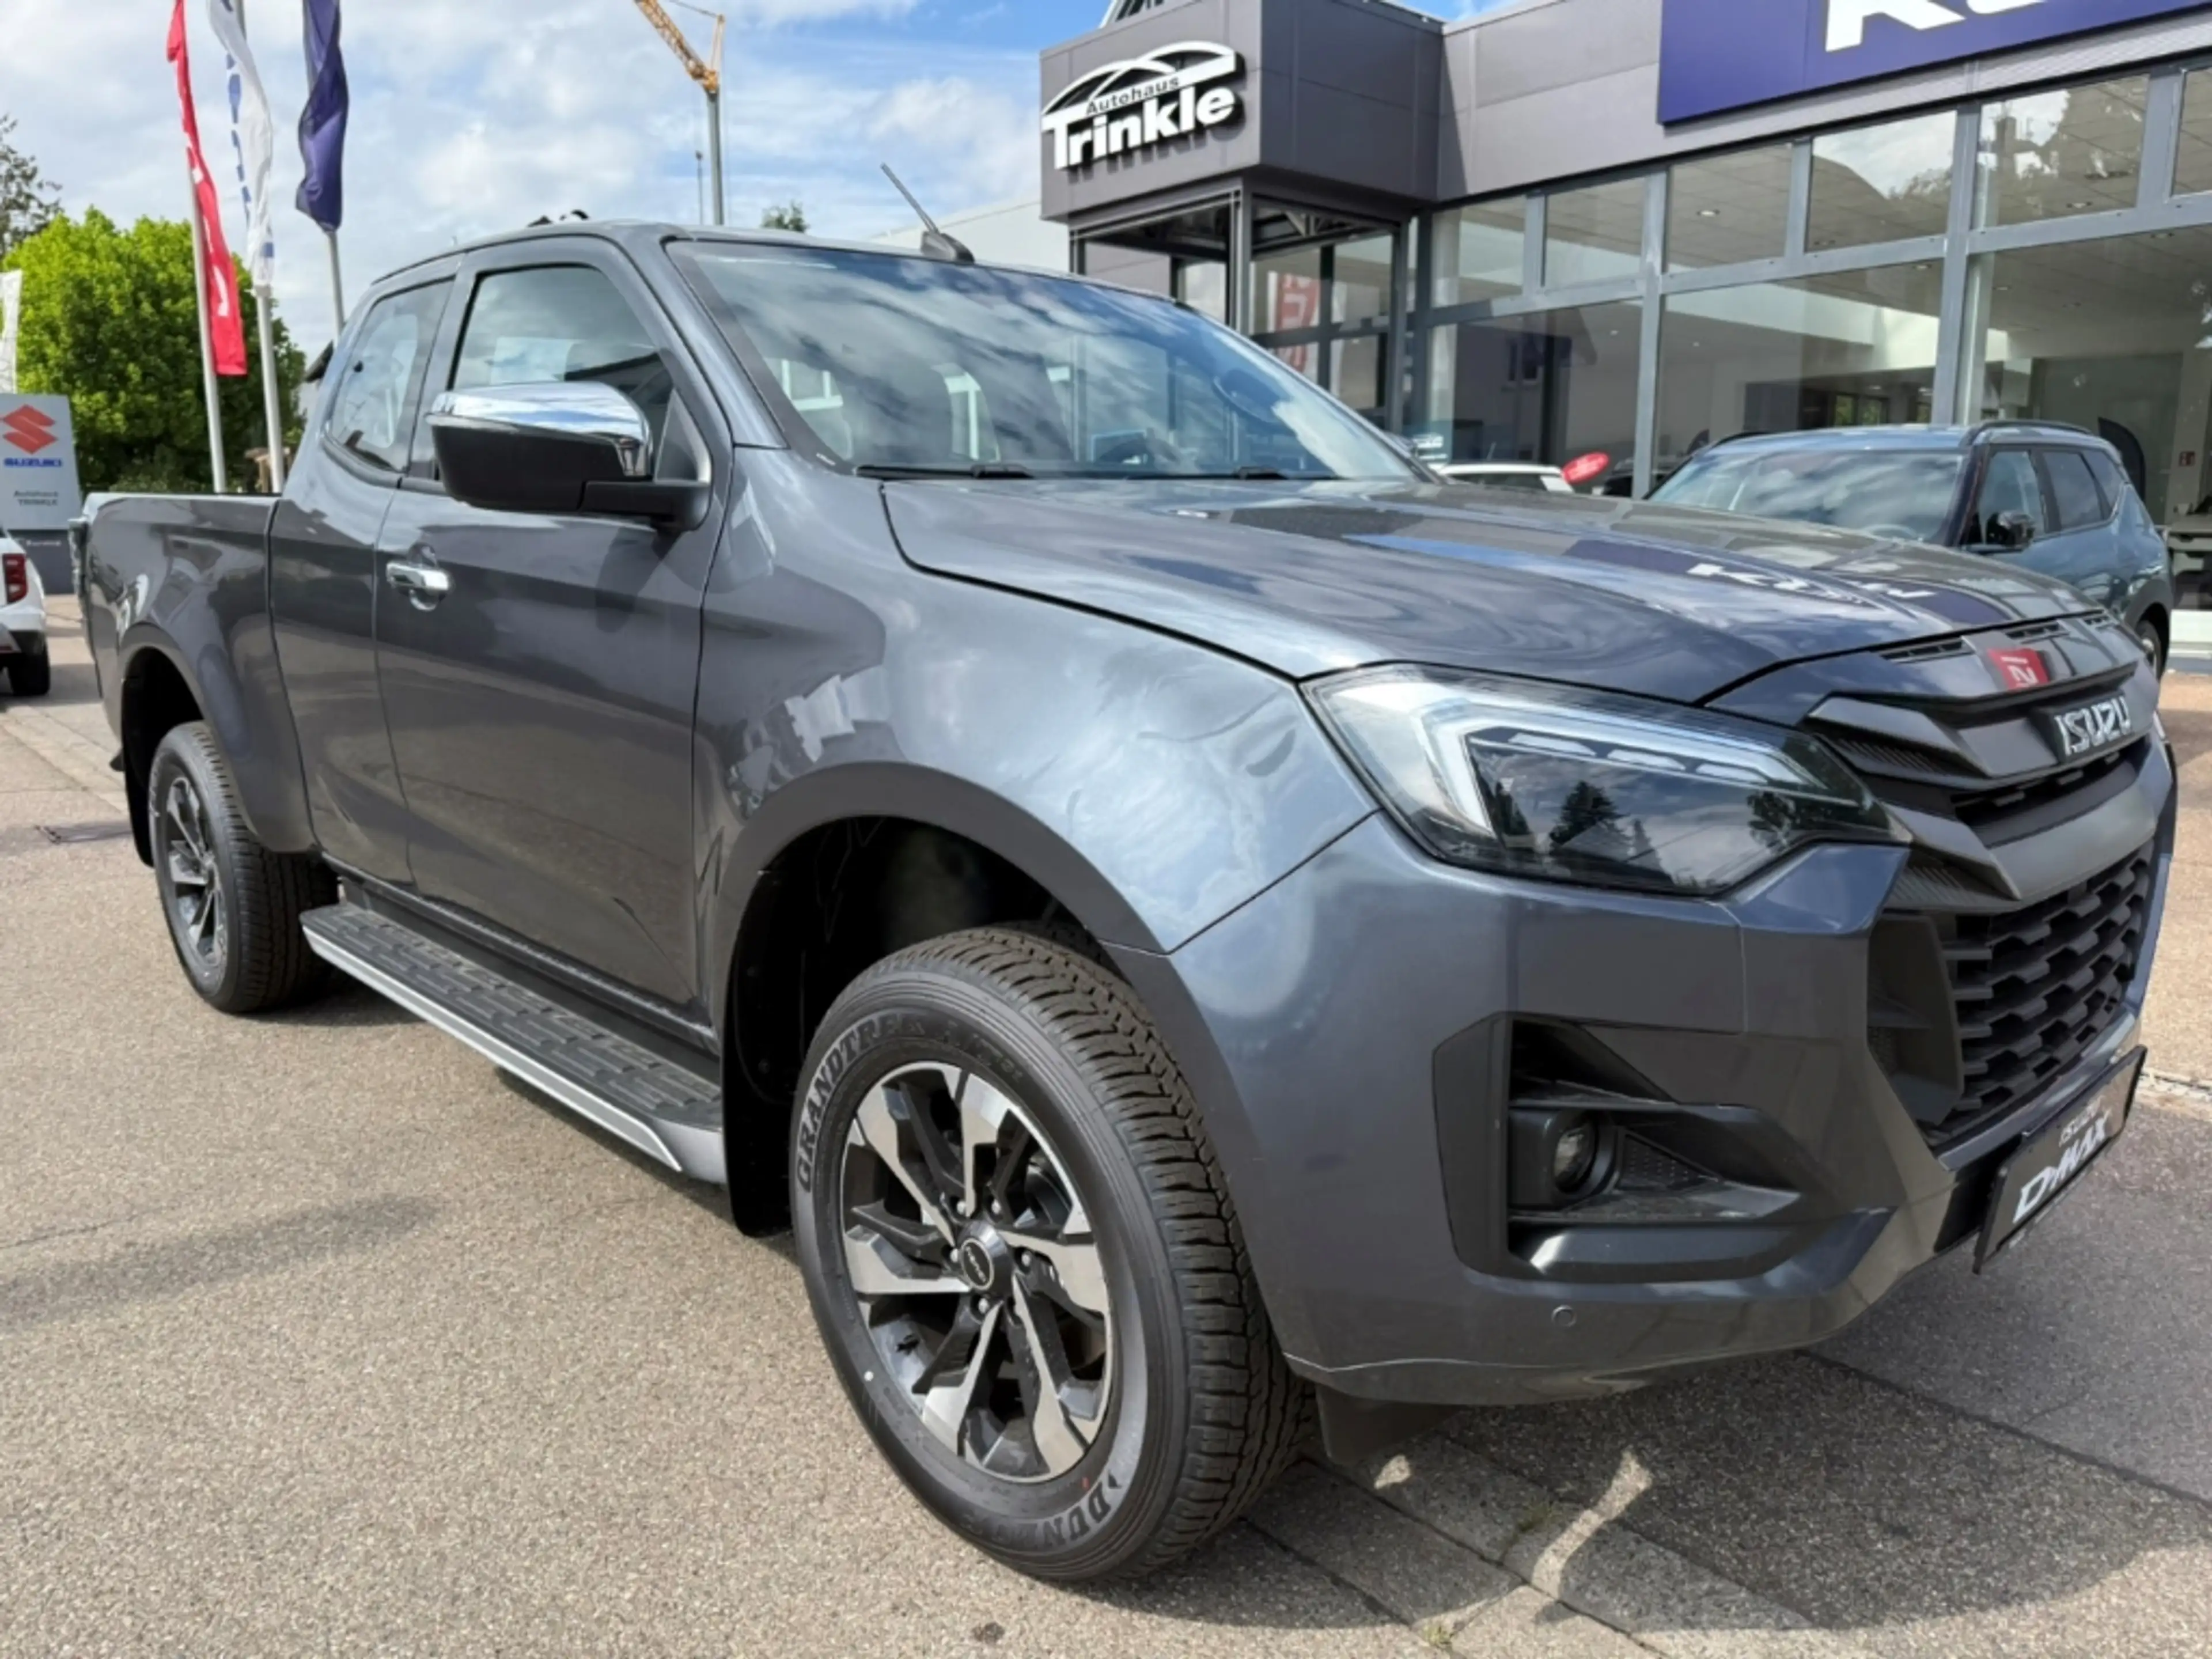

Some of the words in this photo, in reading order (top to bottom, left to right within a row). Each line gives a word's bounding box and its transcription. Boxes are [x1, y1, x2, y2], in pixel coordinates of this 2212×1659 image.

[1086, 77, 1180, 115] Autohaus
[1041, 86, 1236, 170] Trinkle
[2054, 696, 2131, 756] ISUZU
